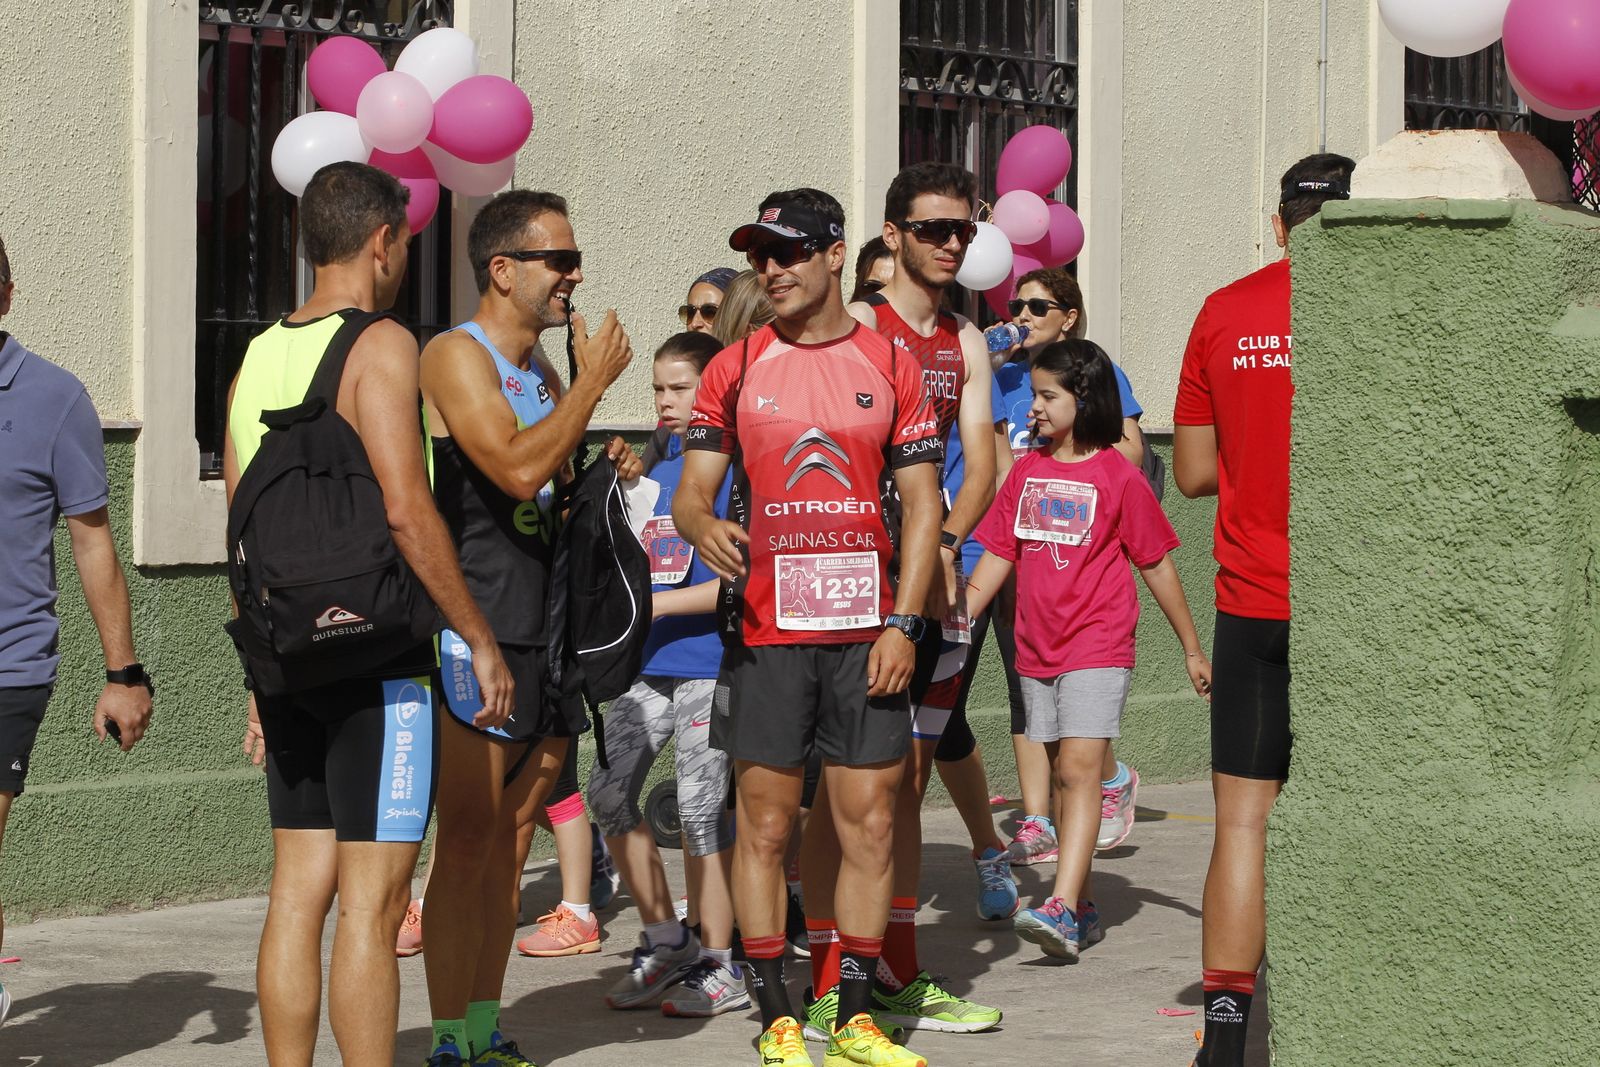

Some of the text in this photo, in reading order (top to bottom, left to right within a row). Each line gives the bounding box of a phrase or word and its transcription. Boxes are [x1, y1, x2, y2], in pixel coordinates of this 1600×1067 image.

[1238, 335, 1281, 350] CLUB
[1233, 353, 1291, 370] M1 SAL
[1039, 498, 1088, 522] 1851
[768, 531, 876, 551] SALINAS CAR
[810, 577, 873, 600] 1232
[312, 623, 374, 642] QUIKSILVER
[451, 643, 468, 702] Blanes
[391, 731, 413, 800] Blanes
[384, 807, 423, 819] Spiuk
